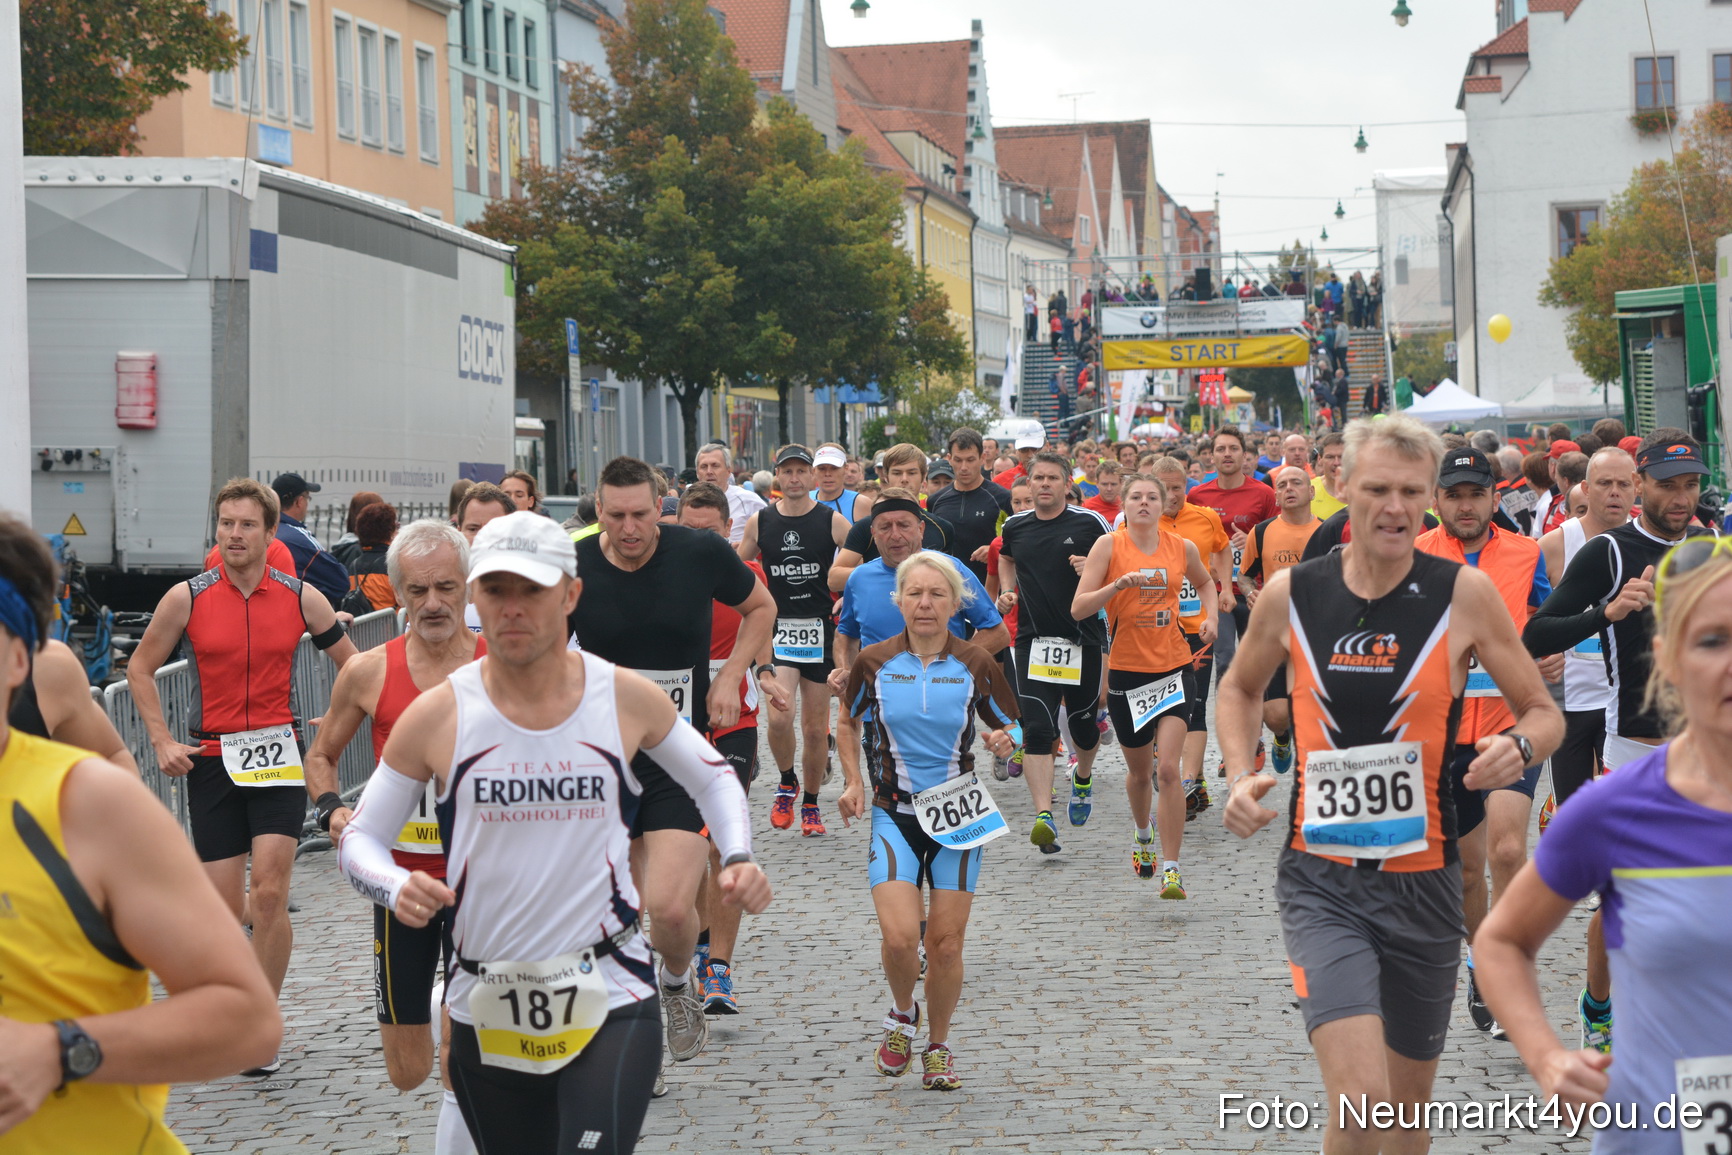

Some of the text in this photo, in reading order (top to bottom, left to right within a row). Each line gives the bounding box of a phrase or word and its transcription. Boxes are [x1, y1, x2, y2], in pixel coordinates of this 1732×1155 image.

[1187, 309, 1267, 320] EfficientDyamics
[458, 314, 505, 385] BOCK
[1169, 343, 1241, 362] START
[778, 629, 820, 646] 2593
[783, 648, 813, 657] Christian
[1042, 646, 1072, 666] 191
[1048, 668, 1063, 677] Uwe
[1136, 679, 1178, 715] 3375
[223, 732, 283, 748] PARTL Neumarkt
[239, 742, 287, 771] 232
[1306, 755, 1401, 774] PARTL Neumarkt
[253, 771, 282, 781] Franz
[507, 760, 573, 775] TEAM
[473, 775, 606, 807] ERDINGER
[914, 781, 971, 807] PARTL Neumarkt
[1317, 770, 1414, 819] 3396
[477, 806, 606, 823] ALKOHOLFREI
[925, 789, 990, 833] 2642
[415, 826, 440, 841] Wil
[950, 824, 987, 844] Marion
[1310, 828, 1396, 847] Reiner
[516, 967, 577, 985] Neumarkt
[498, 984, 579, 1031] 187
[519, 1038, 567, 1058] Klaus
